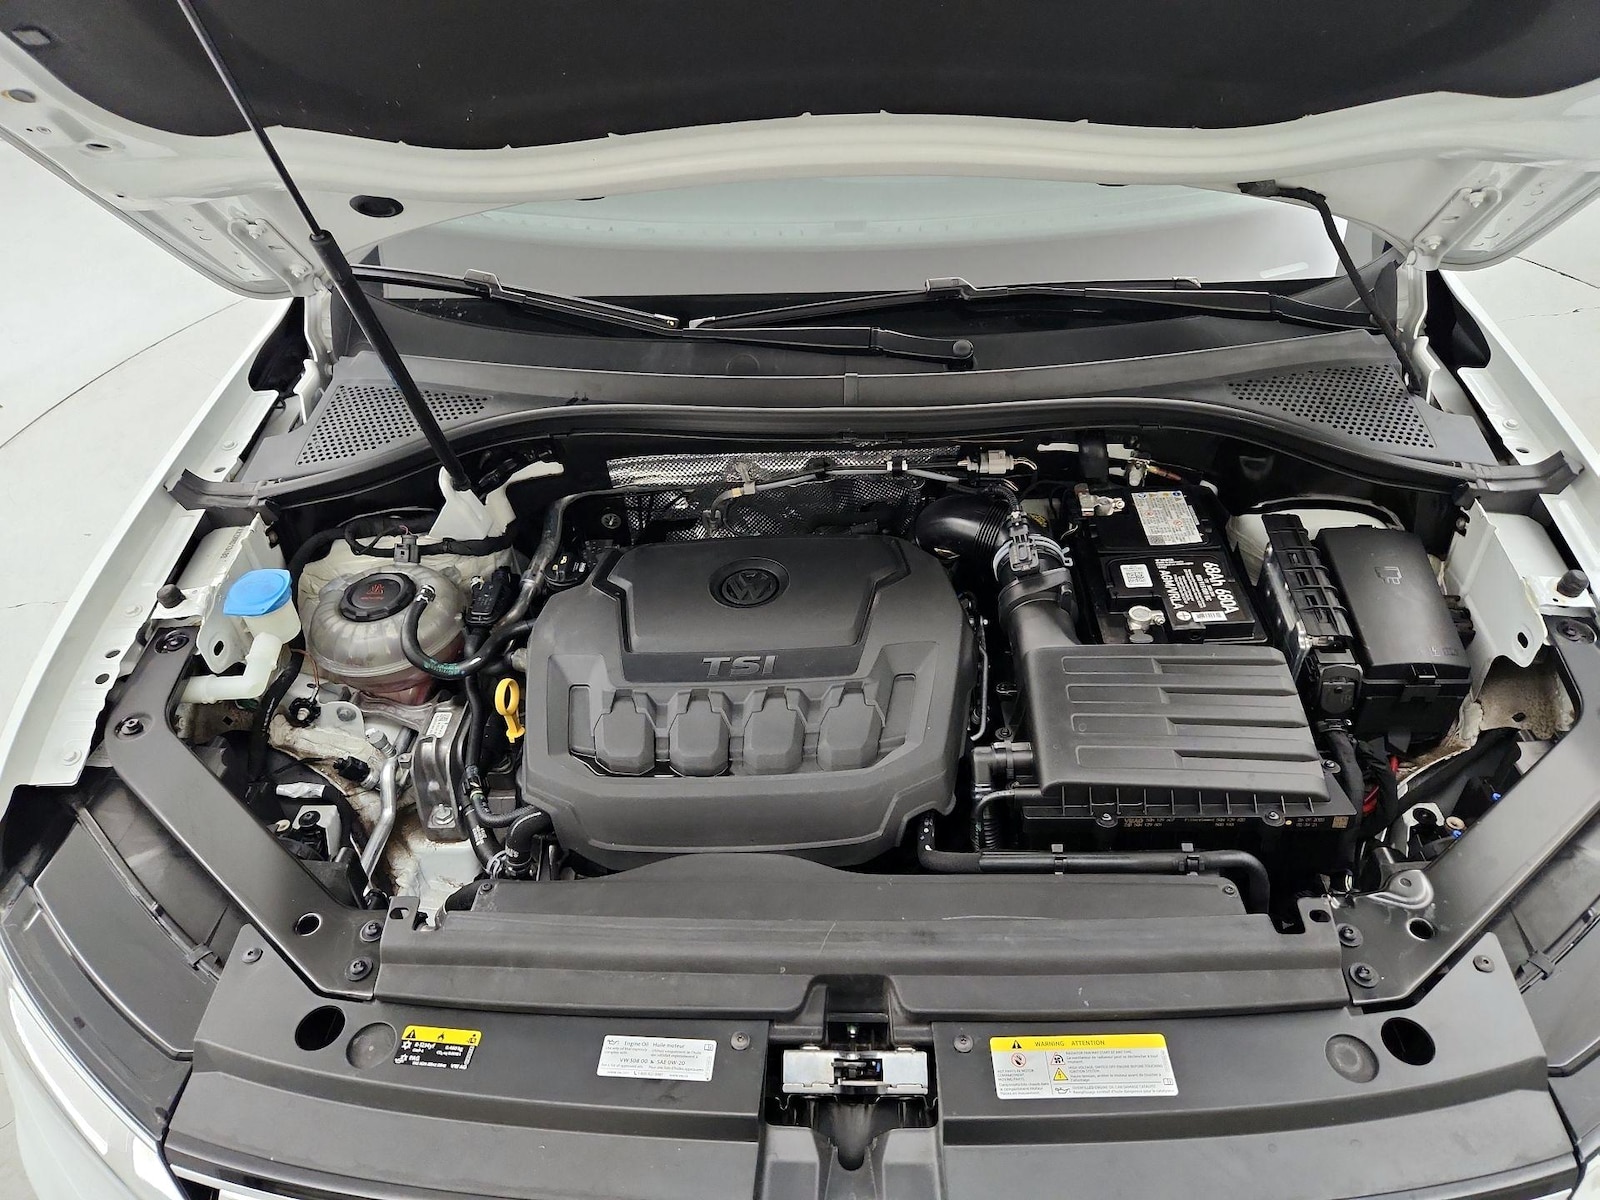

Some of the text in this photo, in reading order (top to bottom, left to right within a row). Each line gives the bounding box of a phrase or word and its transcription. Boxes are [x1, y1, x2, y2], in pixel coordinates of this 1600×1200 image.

[1203, 561, 1239, 614] 68Ah 680A
[702, 655, 778, 678] TSI
